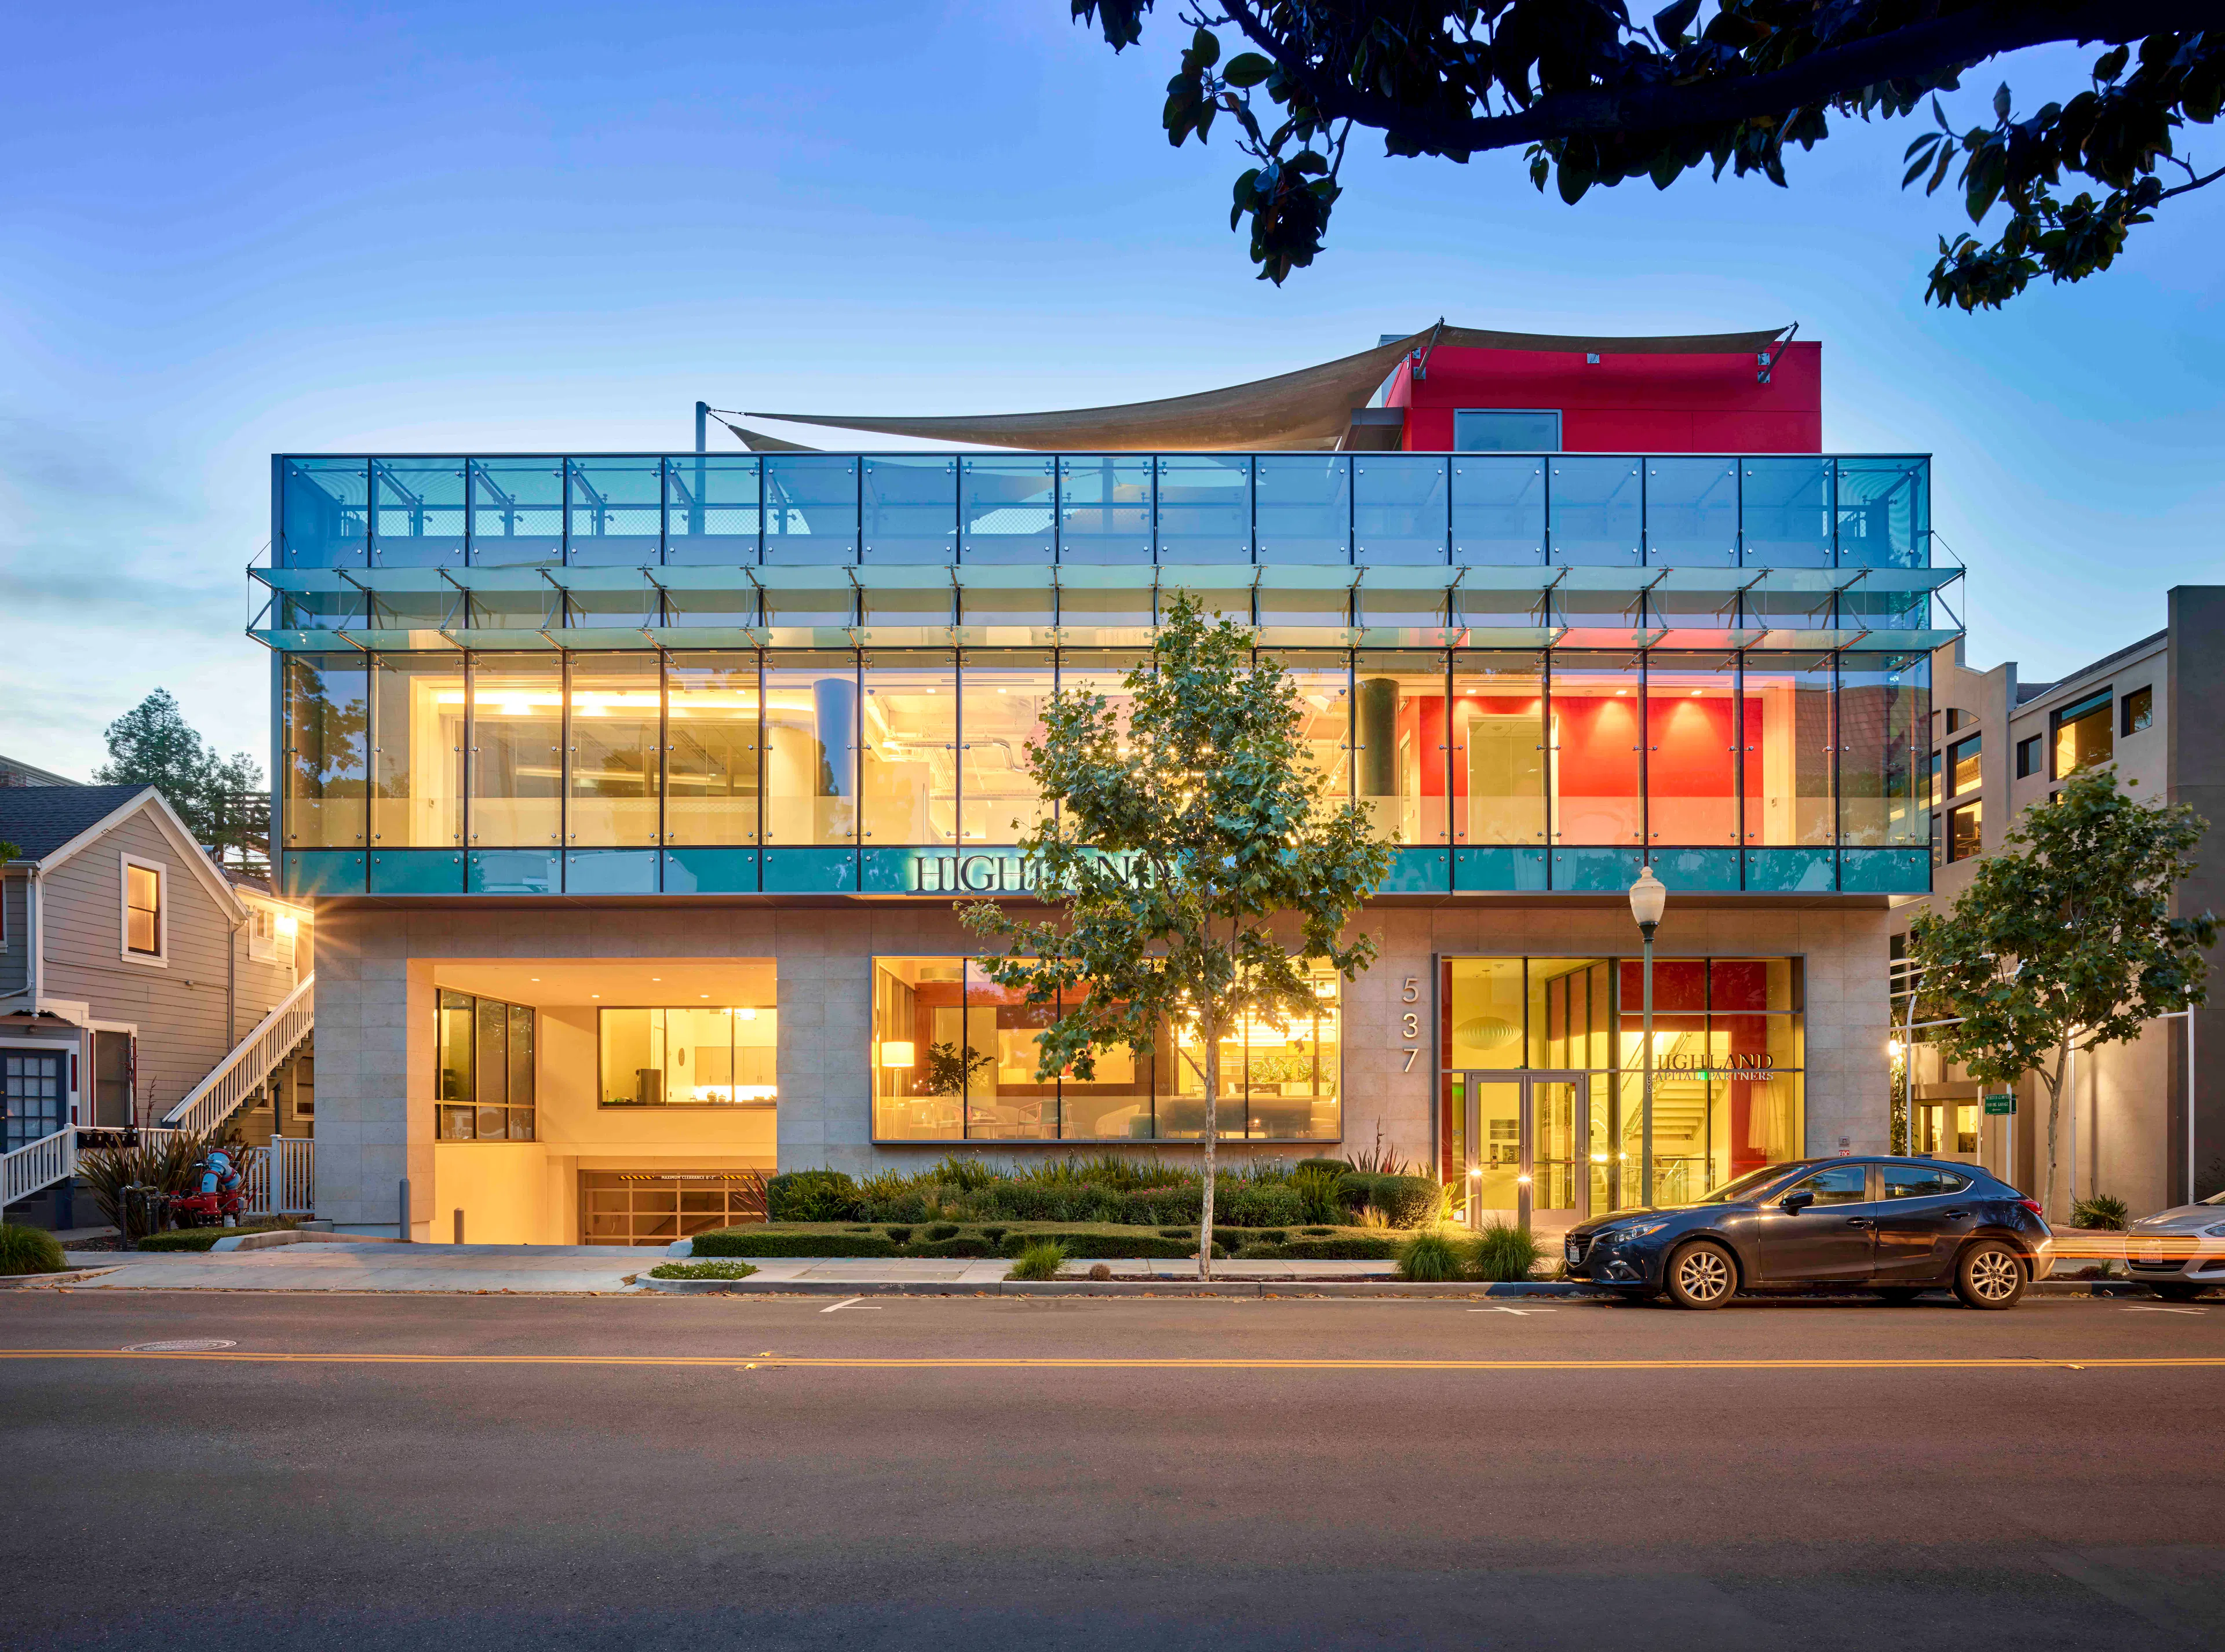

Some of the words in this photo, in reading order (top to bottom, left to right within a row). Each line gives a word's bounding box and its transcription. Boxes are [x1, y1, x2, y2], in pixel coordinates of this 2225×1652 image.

[1402, 978, 1419, 1073] 537
[1652, 1072, 1701, 1081] APITAL
[1708, 1072, 1774, 1081] PARTNERS
